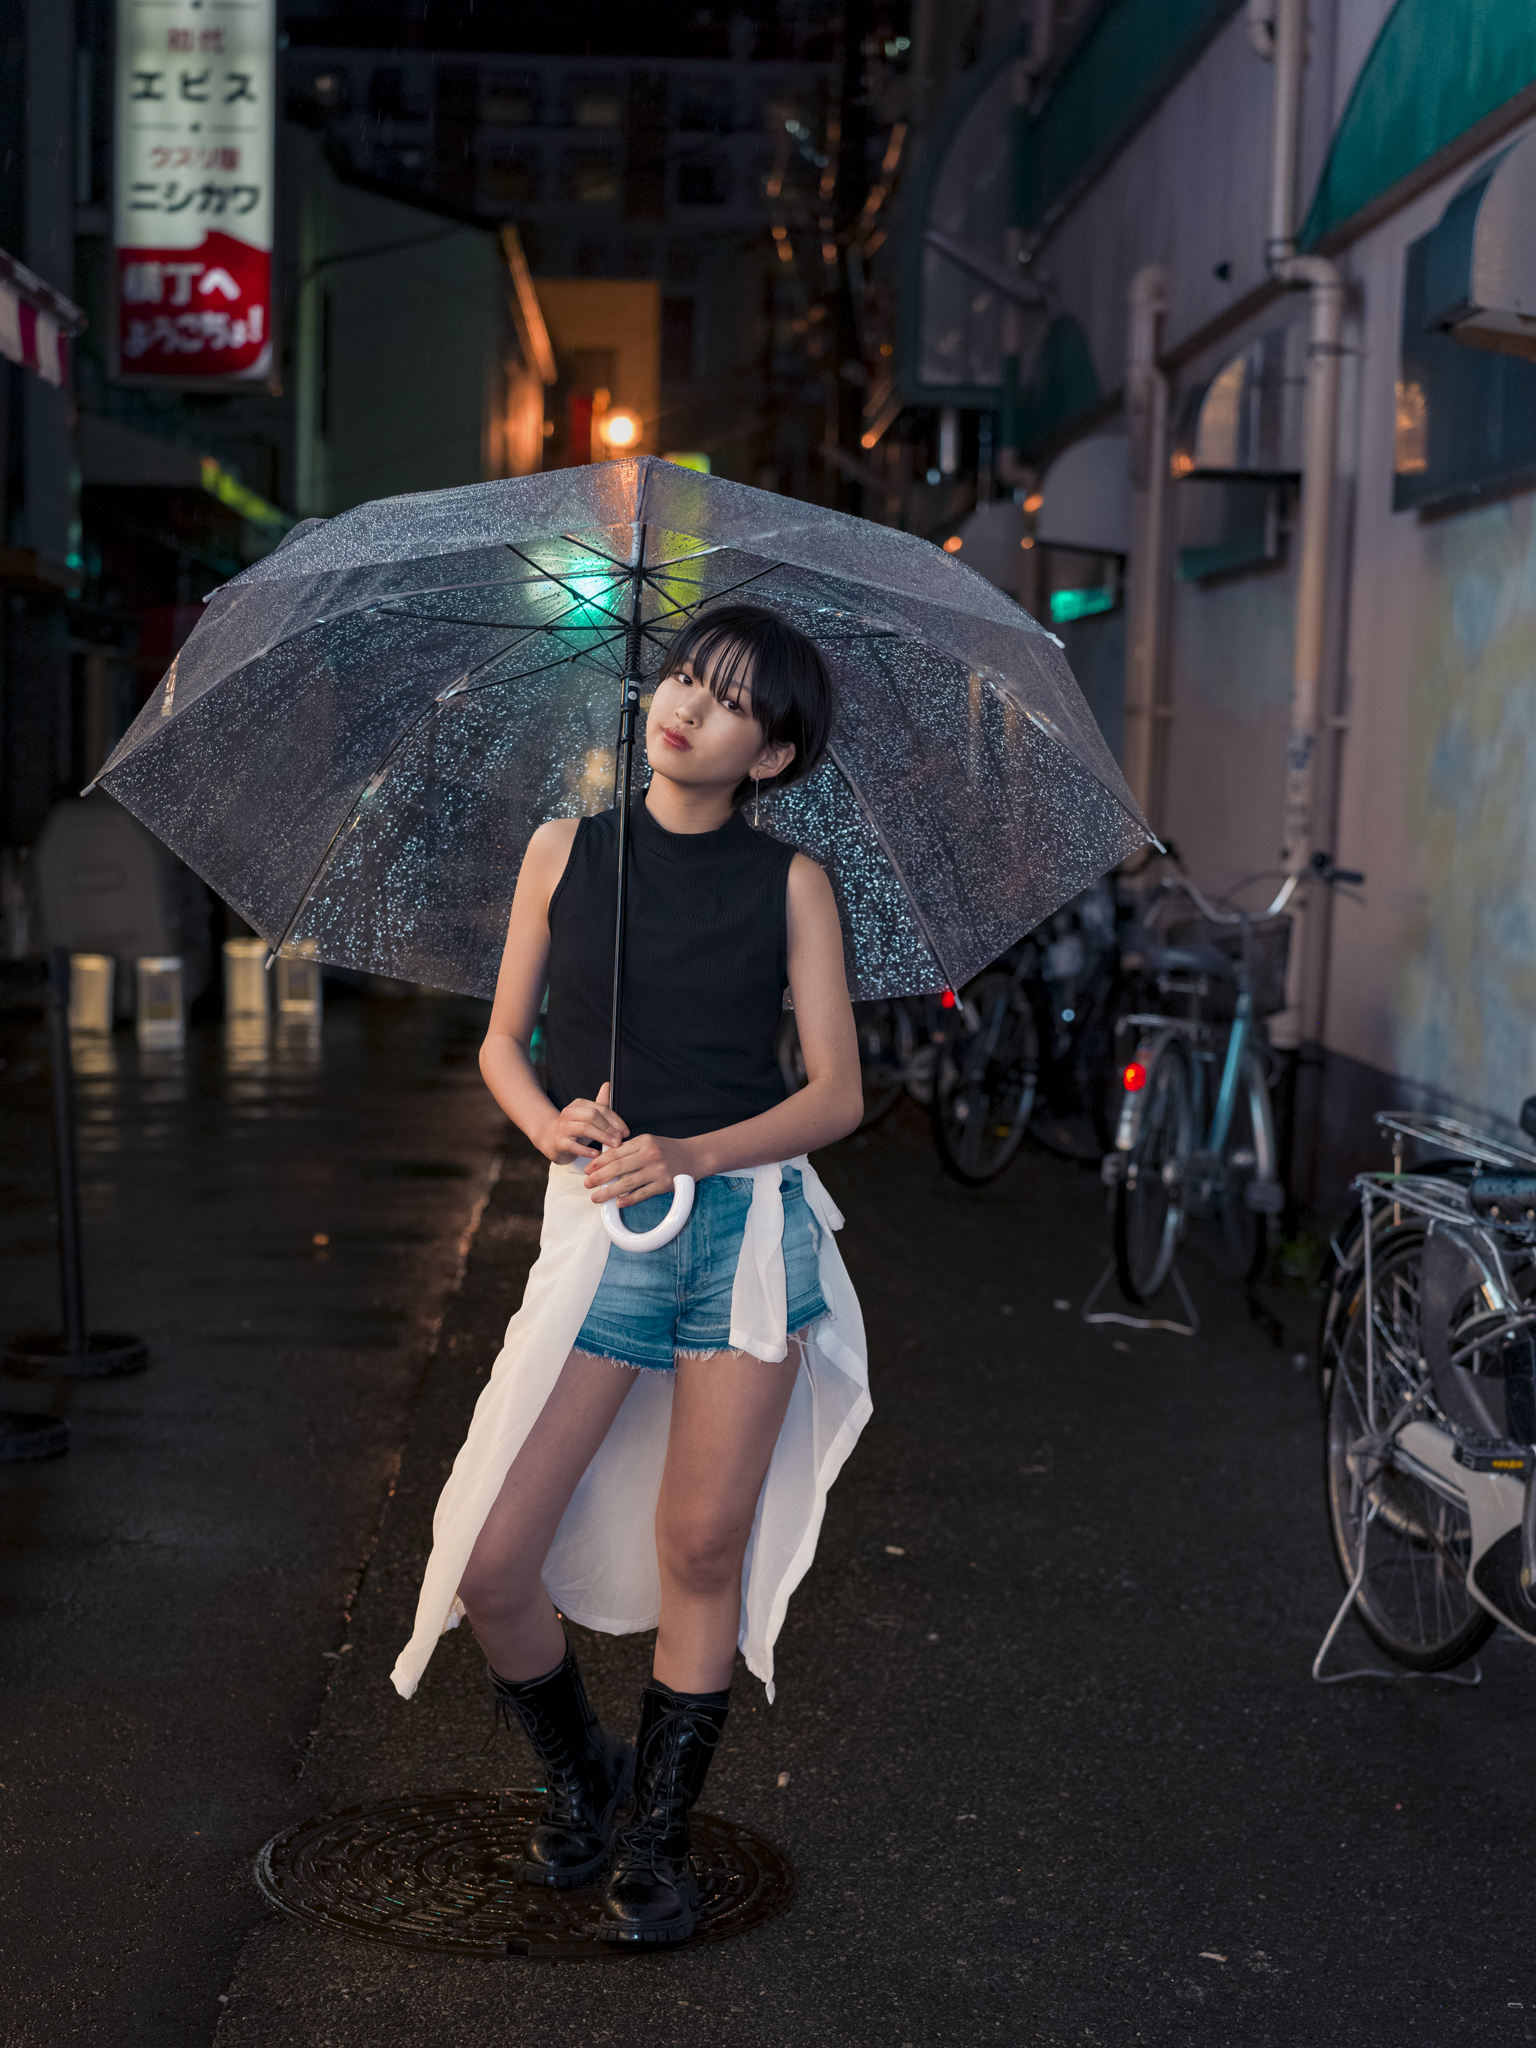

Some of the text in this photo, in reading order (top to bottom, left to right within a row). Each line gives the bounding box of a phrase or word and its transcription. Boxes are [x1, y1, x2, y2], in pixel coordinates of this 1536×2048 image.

[130, 68, 257, 104] エビス
[129, 181, 260, 216] ニシカワ
